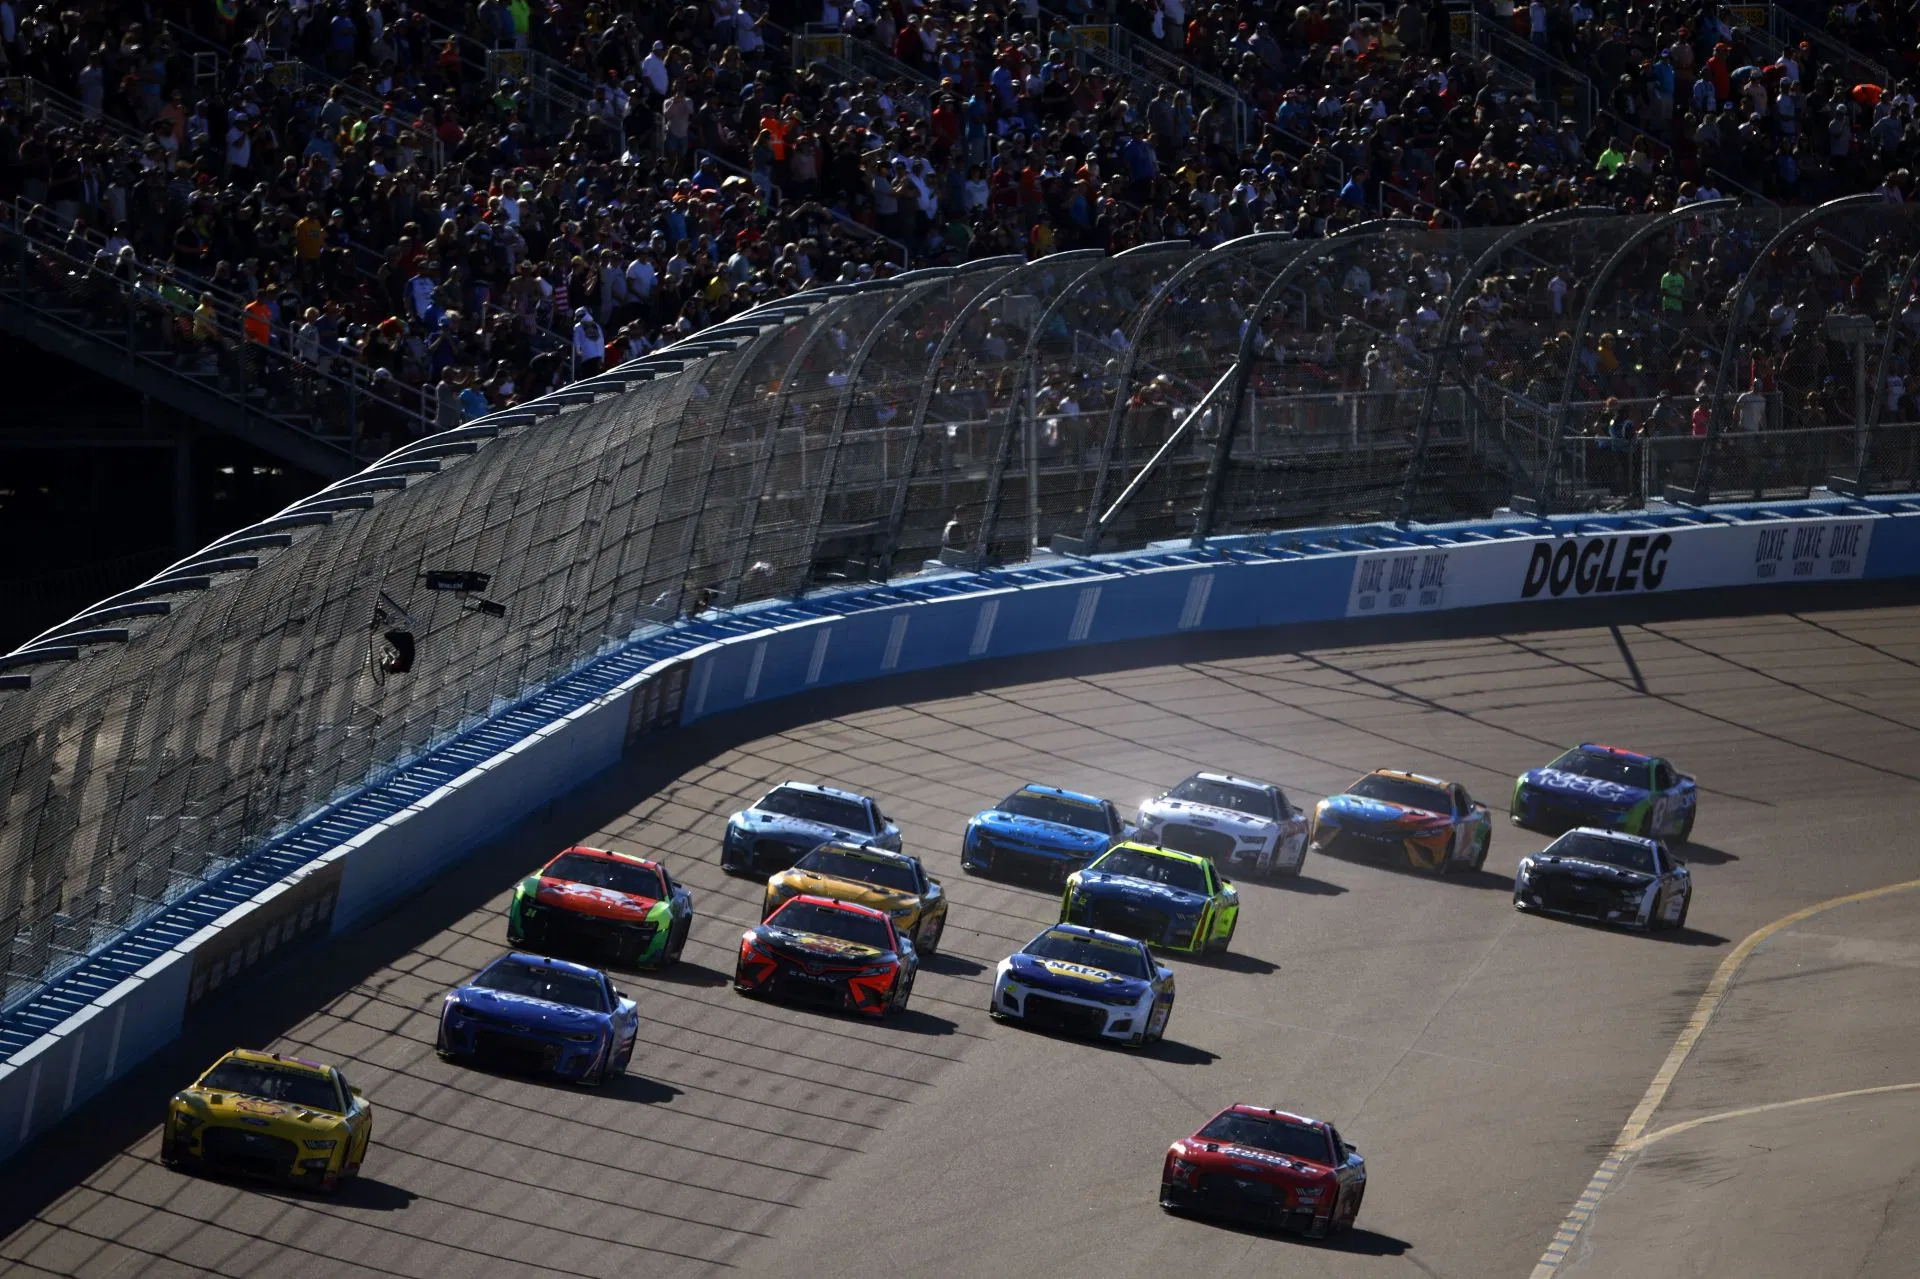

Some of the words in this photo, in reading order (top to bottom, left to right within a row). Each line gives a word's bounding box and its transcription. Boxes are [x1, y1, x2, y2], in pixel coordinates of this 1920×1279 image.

[1756, 528, 1788, 563] DIXIE
[1792, 526, 1825, 560] DIXIE
[1829, 524, 1863, 558] DIXIE
[1521, 534, 1671, 597] DOGLEG
[1050, 961, 1107, 979] NAPA
